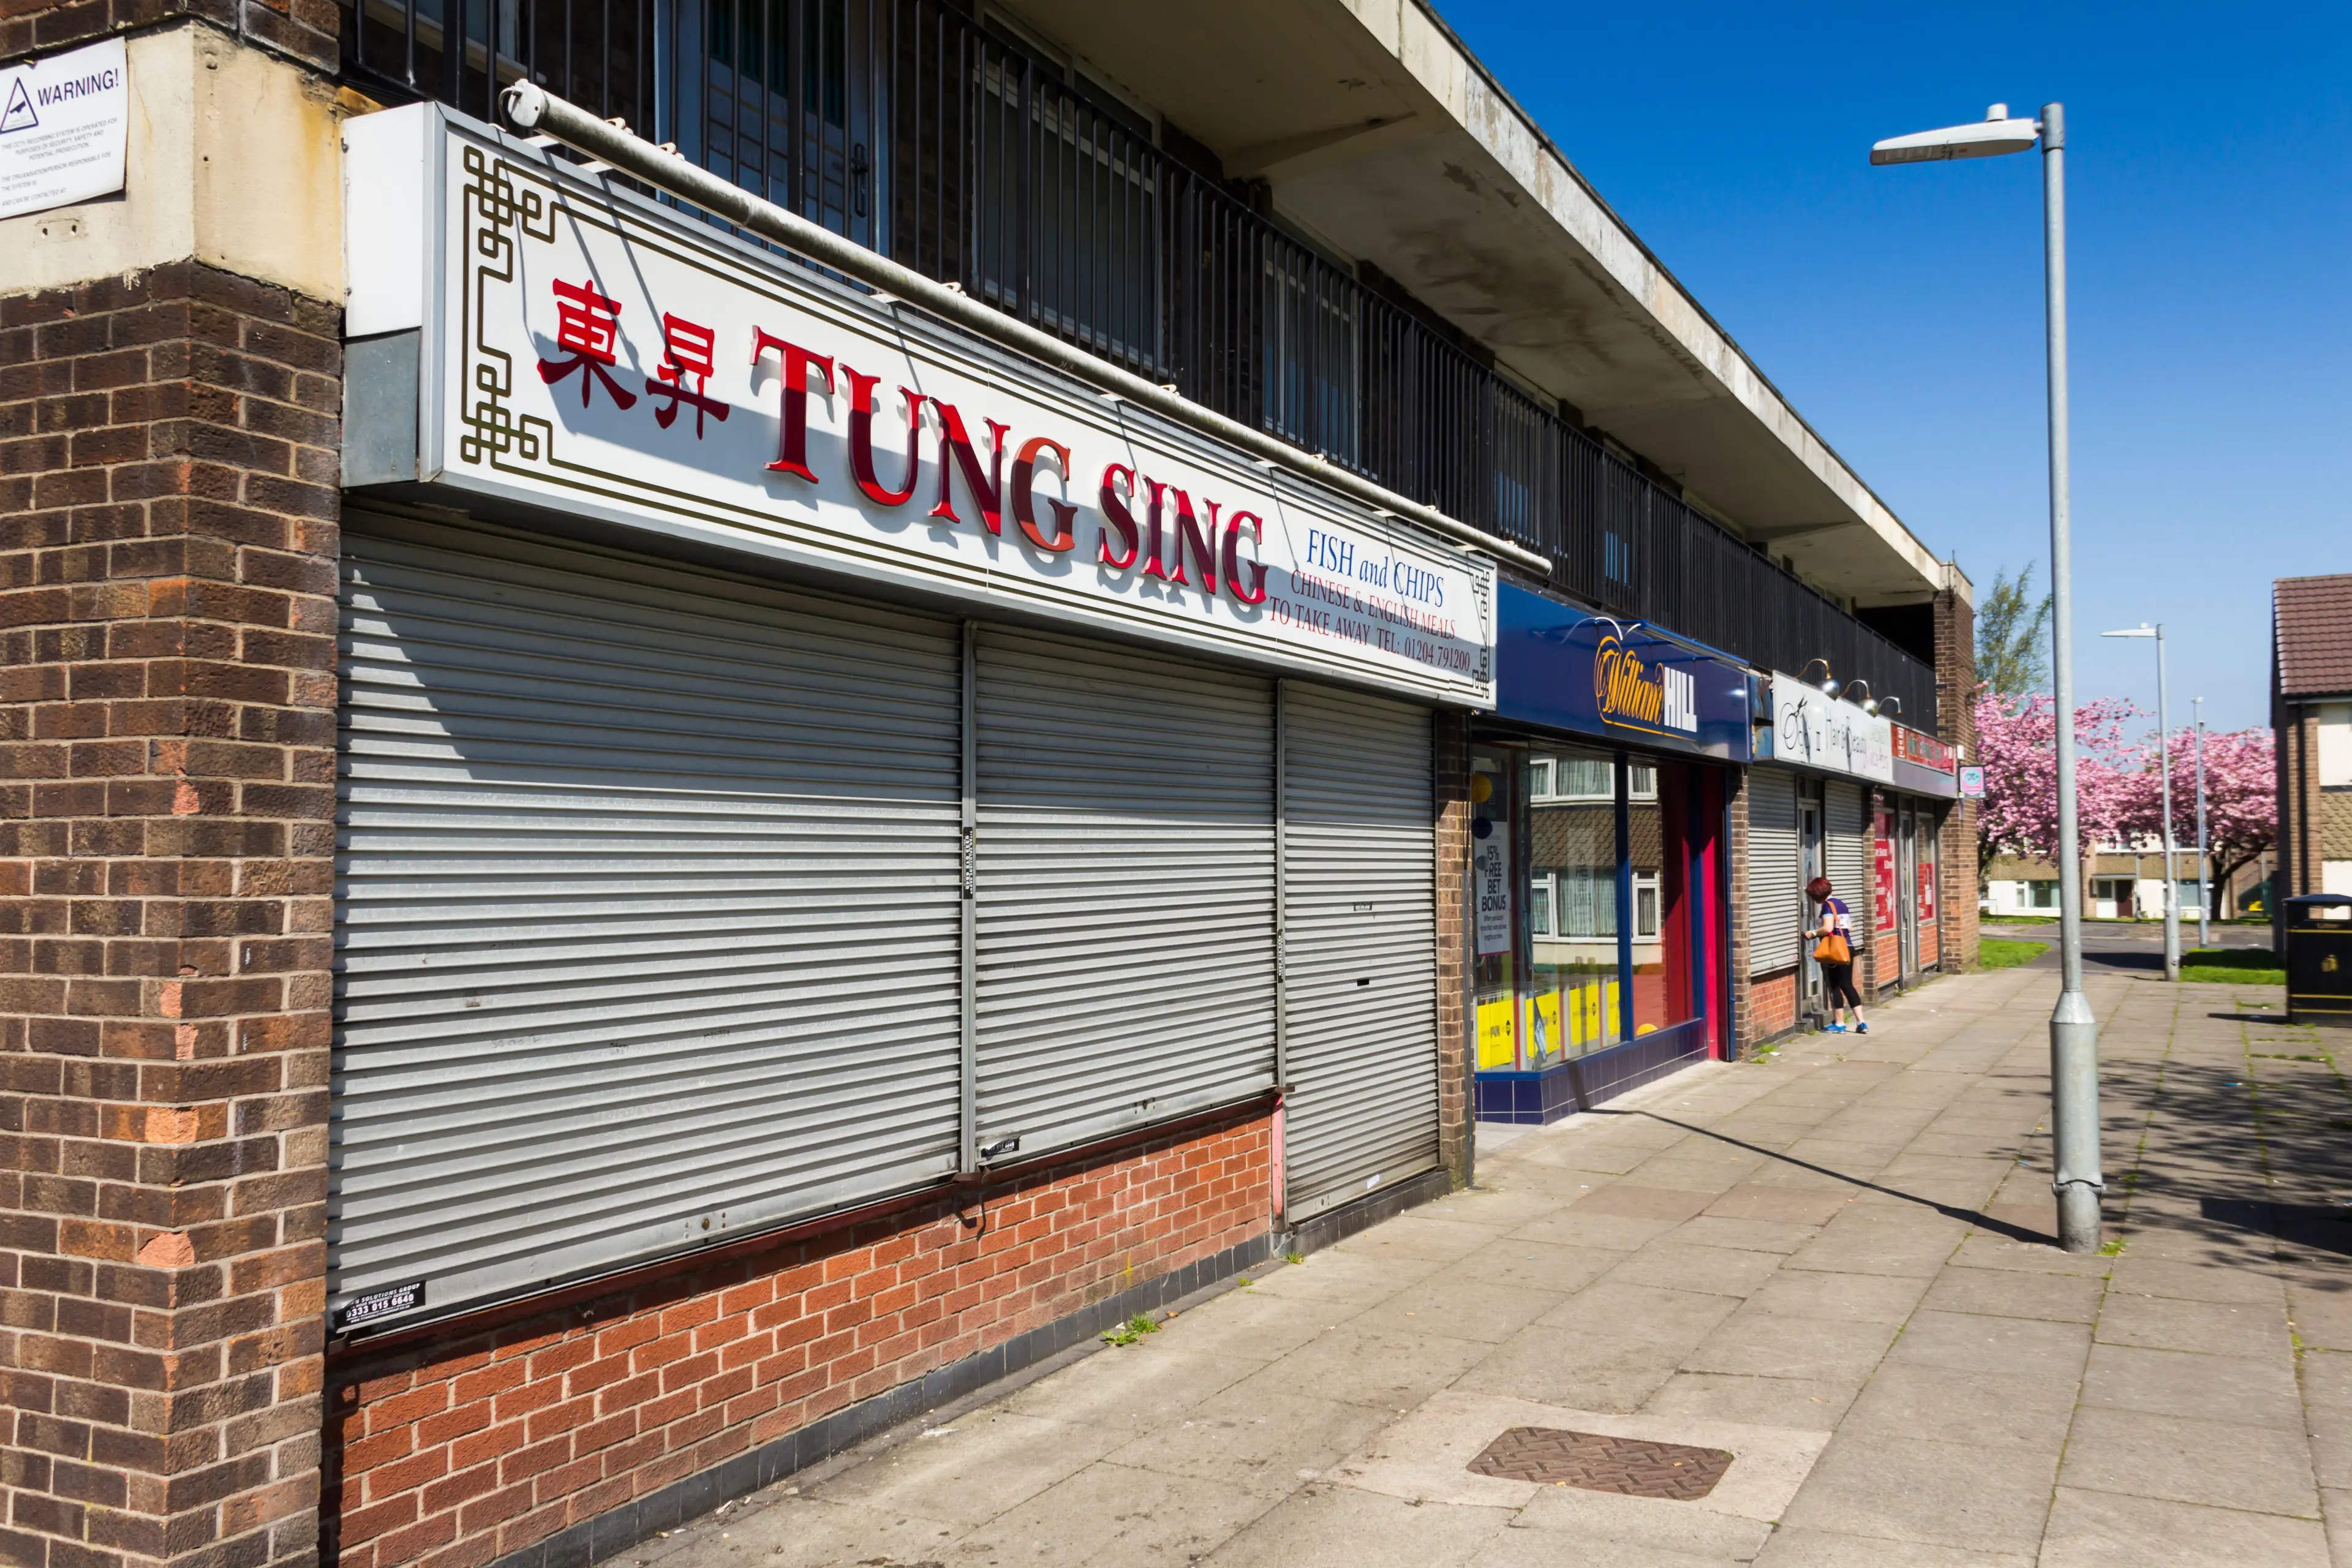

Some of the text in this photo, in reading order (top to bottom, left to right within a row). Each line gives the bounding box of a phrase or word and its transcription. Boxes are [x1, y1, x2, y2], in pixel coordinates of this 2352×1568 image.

[37, 68, 119, 107] WARNING!
[537, 278, 731, 440] 東昇
[750, 324, 1269, 606] TUNG SING
[1306, 528, 1444, 608] FISH and CHIPS
[1291, 569, 1456, 639] CHINESE & ENGLISH MEALS
[1269, 595, 1471, 672] TO TAKE AWAY TEL: 01204 791200
[1594, 636, 1665, 725] William
[1664, 666, 1697, 733] HILL
[1487, 845, 1499, 861] 15%
[1481, 894, 1506, 913] BONUS
[1487, 879, 1501, 895] BET
[346, 1305, 369, 1319] 0333
[372, 1300, 389, 1311] 015
[391, 1293, 415, 1306] 6640
[361, 1289, 398, 1303] SOLUTIONS
[399, 1283, 420, 1293] GROUP
